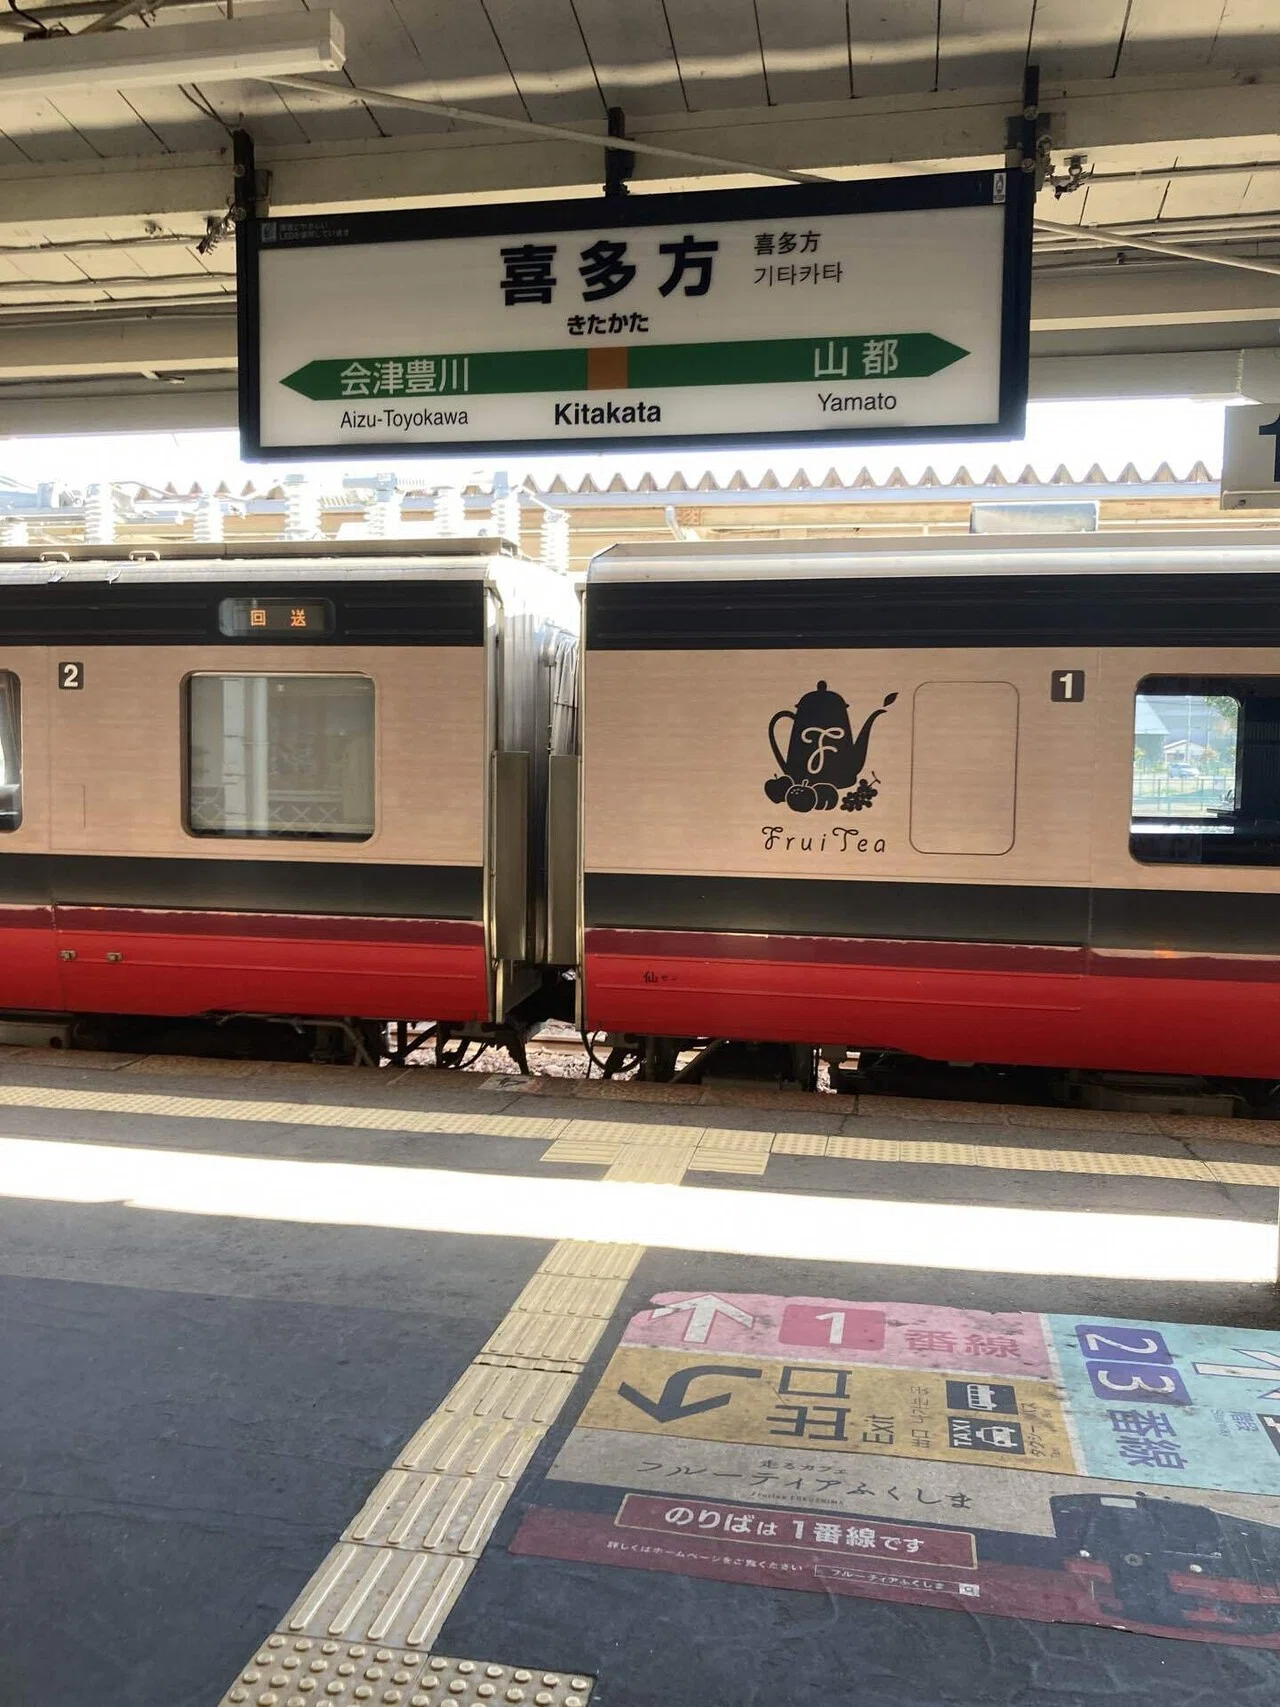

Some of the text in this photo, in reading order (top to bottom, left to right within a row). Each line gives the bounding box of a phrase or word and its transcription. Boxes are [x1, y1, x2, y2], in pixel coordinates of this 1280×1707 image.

[754, 230, 821, 256] 喜多方
[500, 235, 718, 306] 喜多方
[754, 262, 843, 287] 기타카타
[567, 313, 649, 336] きたかた
[814, 339, 899, 377] 山都
[340, 358, 469, 396] 会津豊川
[554, 402, 661, 426] Kitakata
[818, 392, 897, 413] Yamato
[340, 408, 469, 431] Aizu-Toyokawa
[250, 608, 307, 628] 回送
[63, 664, 79, 688] 2
[1059, 672, 1074, 699] 1
[761, 826, 887, 853] FruiTea
[816, 1311, 1022, 1359] 1 番線
[766, 1365, 853, 1442] 出口
[1085, 1333, 1189, 1470] 2 3 番線
[862, 1414, 895, 1445] Exit
[952, 1419, 973, 1447] TAXI
[636, 1460, 974, 1509] フルーティアふくしま
